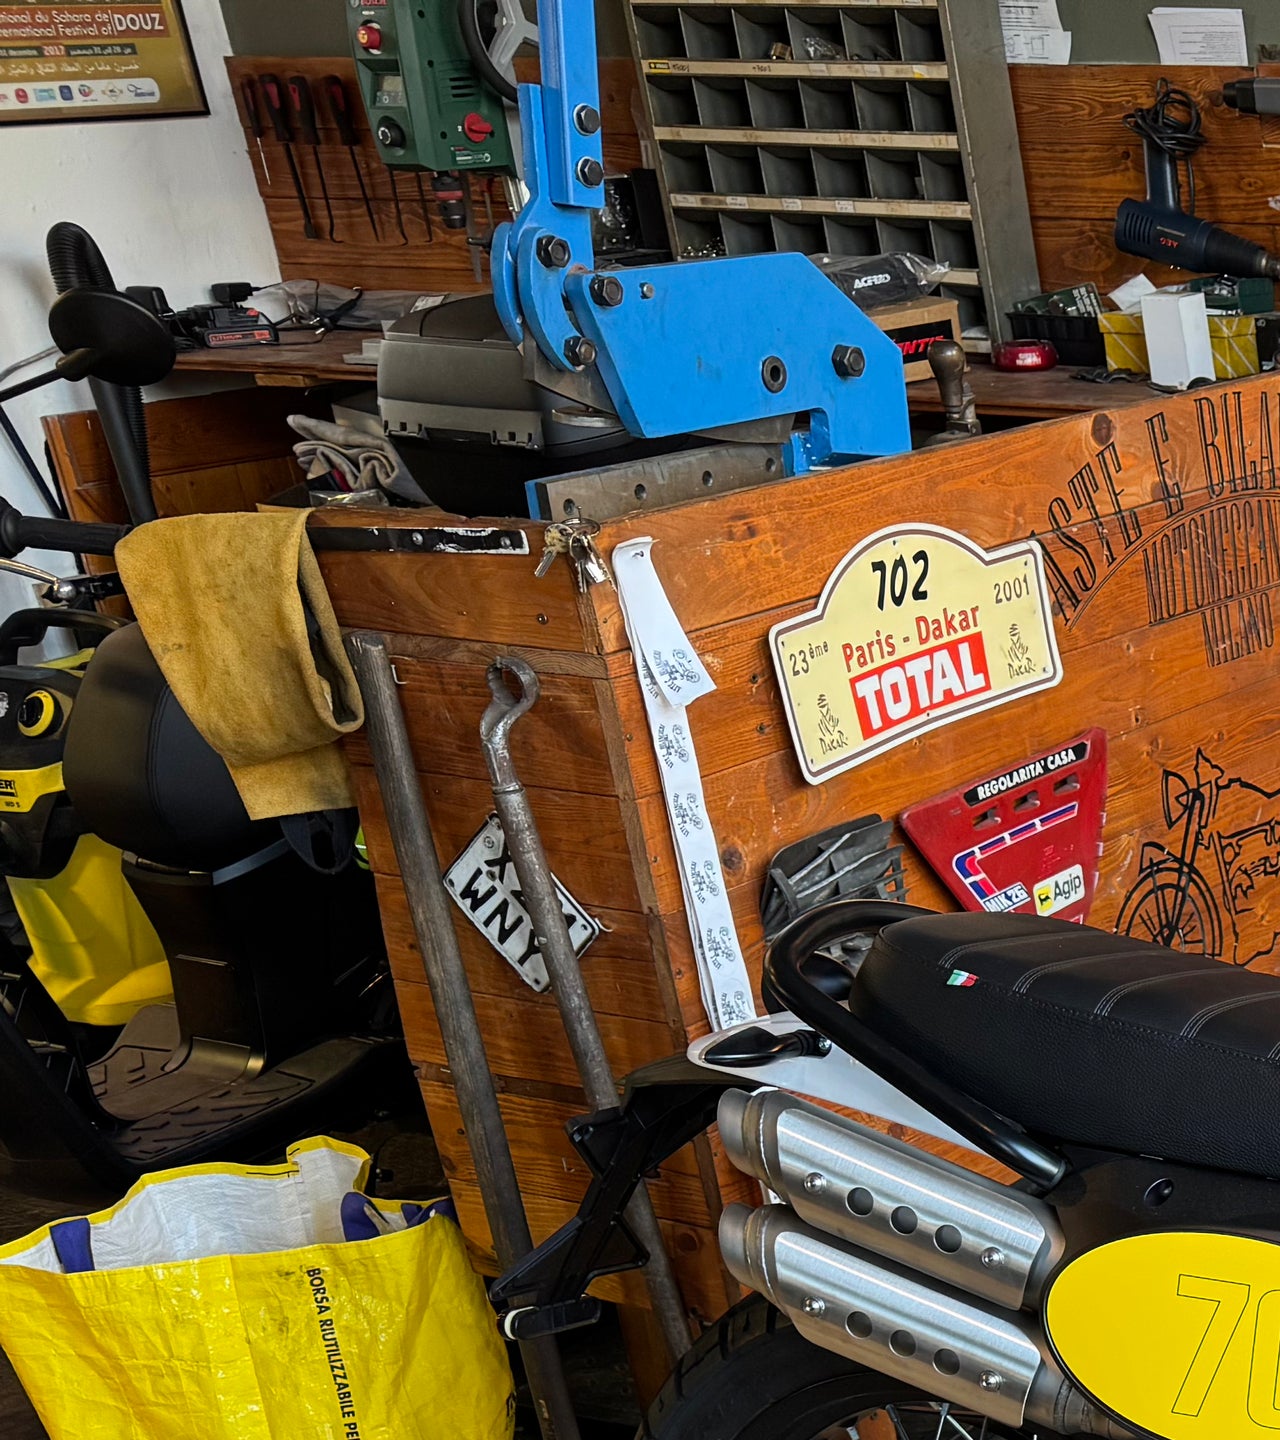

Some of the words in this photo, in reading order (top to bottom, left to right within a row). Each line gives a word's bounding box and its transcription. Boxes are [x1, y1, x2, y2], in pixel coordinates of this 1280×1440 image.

[35, 10, 48, 22] du
[51, 10, 92, 23] Sahara
[57, 24, 98, 36] Festival
[101, 24, 112, 35] of
[113, 13, 164, 31] DOUZ
[43, 45, 65, 56] 2017
[1145, 411, 1184, 519] E
[871, 549, 929, 612] 702
[993, 574, 1031, 605] 2001
[842, 630, 897, 673] Paris
[915, 605, 980, 646] Dakar
[1200, 591, 1276, 668] MILANO
[789, 639, 829, 677] 23ème
[855, 641, 986, 731] TOTAL
[976, 759, 1046, 801] REGOLARITA'
[1047, 748, 1077, 771] CASA
[1052, 873, 1082, 901] Agip
[306, 1267, 331, 1315] BORSA
[318, 1318, 356, 1420] RIUTILIZZABILE
